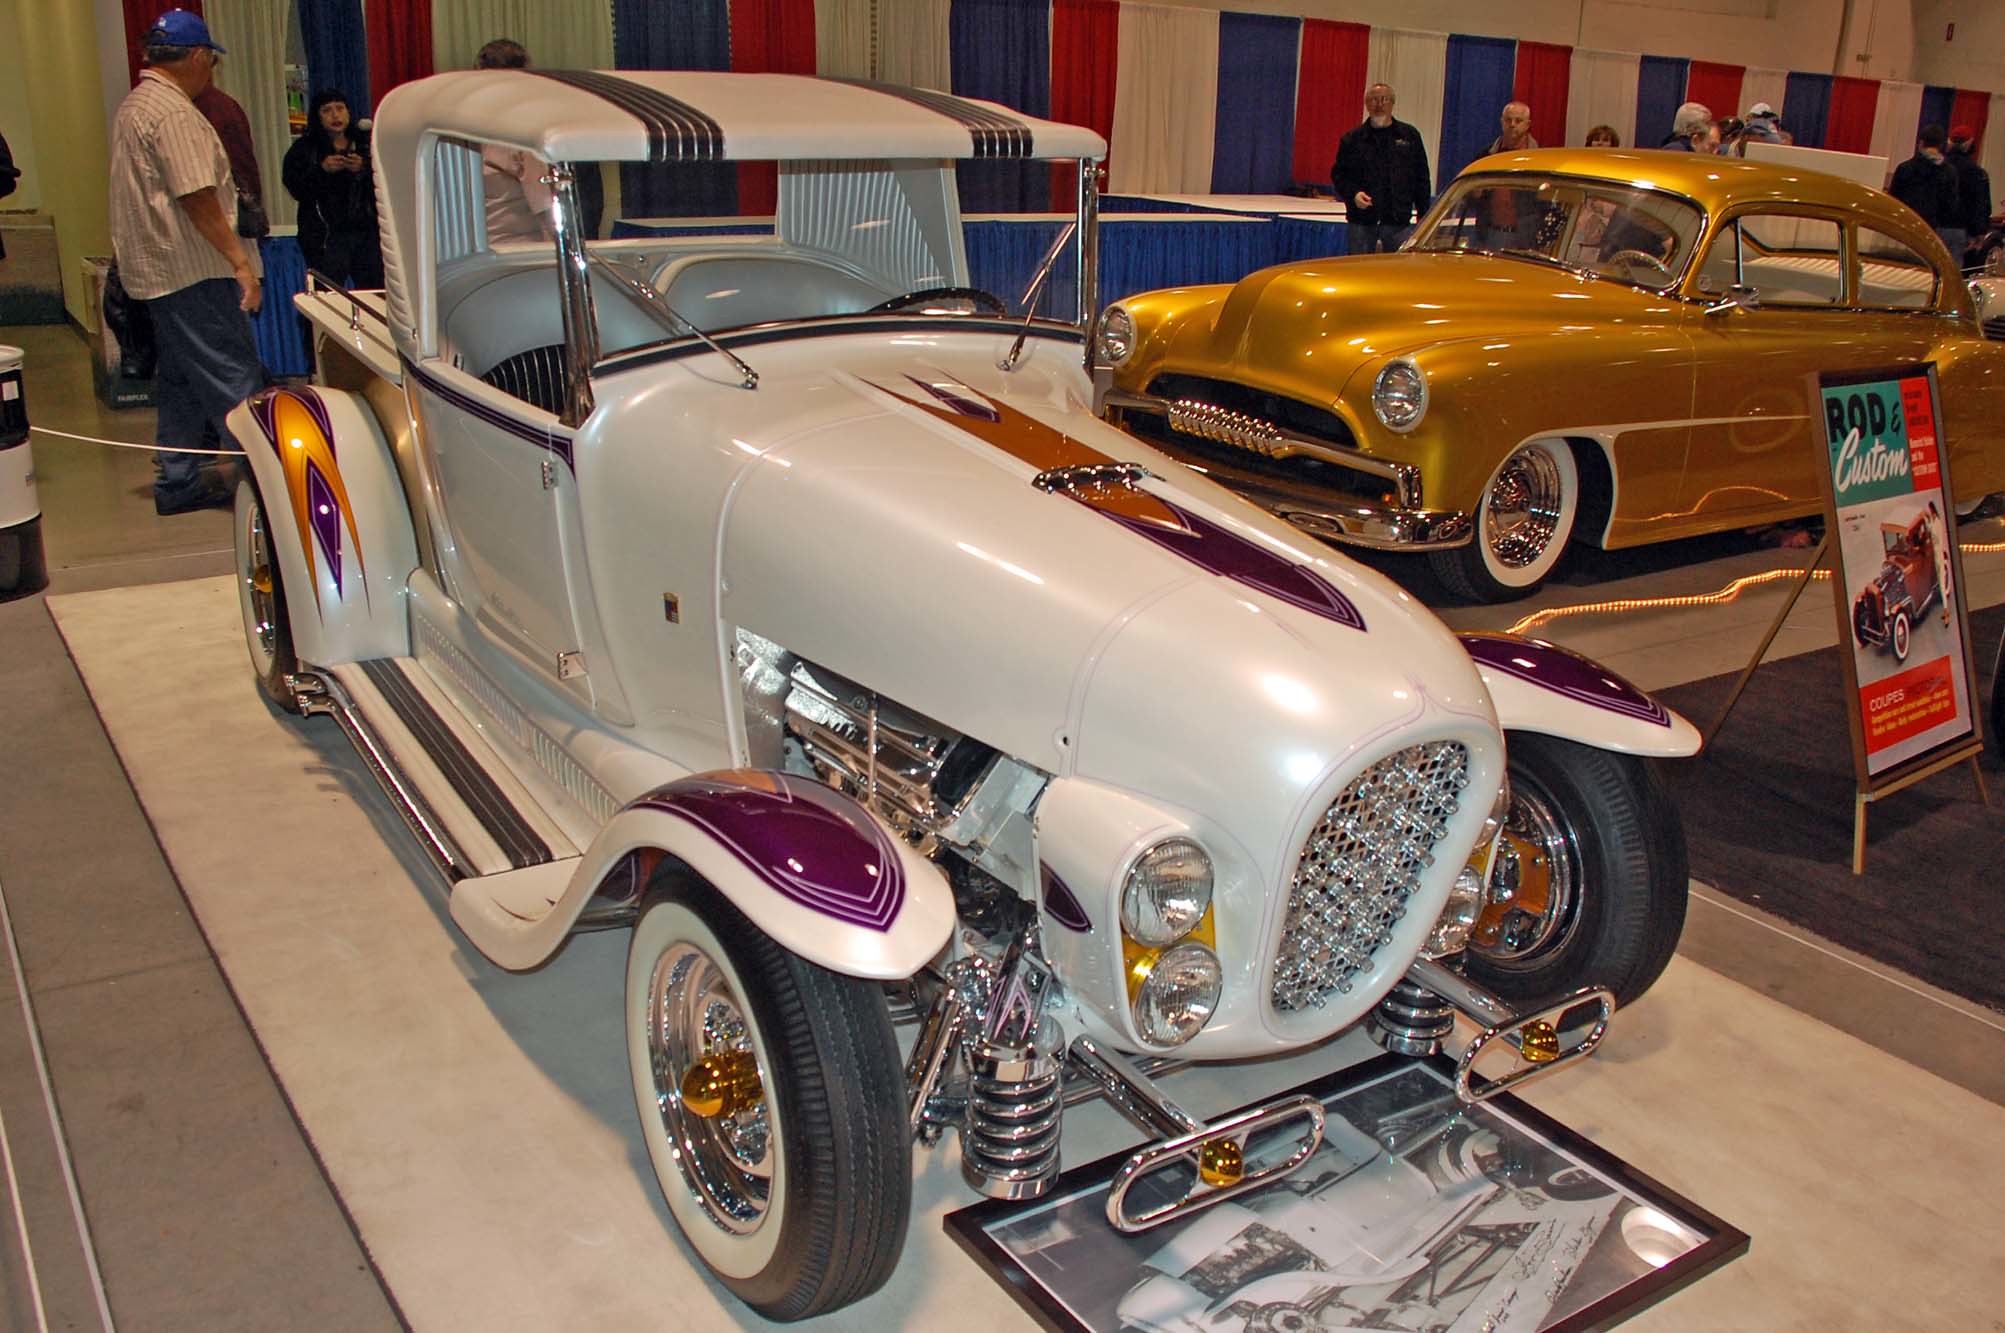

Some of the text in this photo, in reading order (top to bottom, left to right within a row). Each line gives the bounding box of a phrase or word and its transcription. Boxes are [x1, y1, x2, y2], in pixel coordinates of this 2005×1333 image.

[1826, 393, 1885, 443] ROD
[1892, 402, 1901, 436] &
[1836, 427, 1908, 492] Custom
[1870, 689, 1904, 712] COUPES
